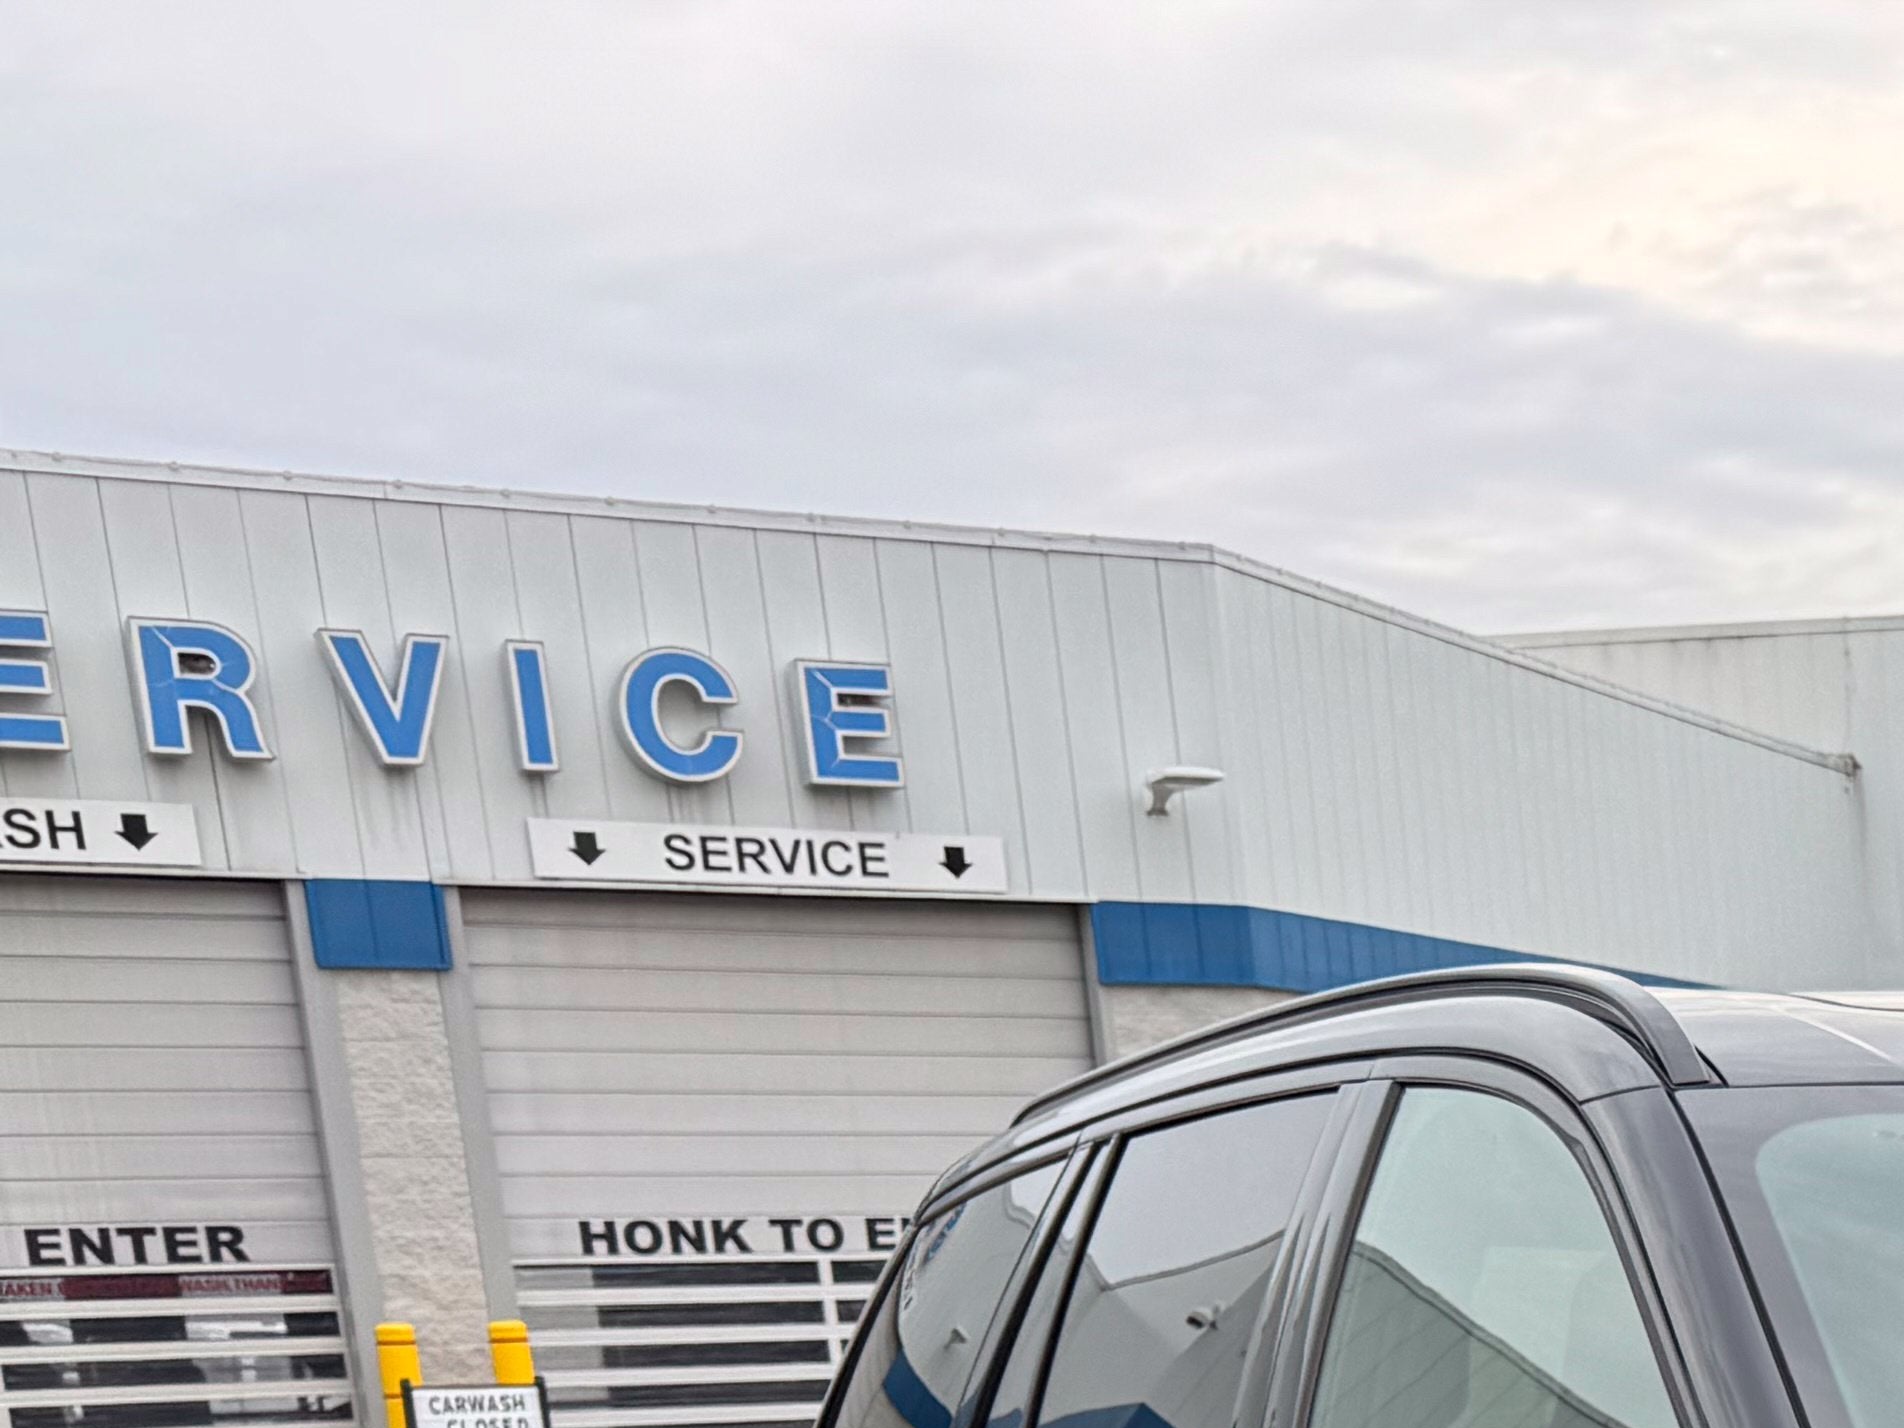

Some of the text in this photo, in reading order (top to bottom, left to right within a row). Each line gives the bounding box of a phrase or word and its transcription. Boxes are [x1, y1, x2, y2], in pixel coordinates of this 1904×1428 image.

[0, 808, 86, 851] SH
[663, 832, 891, 879] SERVICE
[23, 1225, 252, 1267] ENTER
[579, 1219, 753, 1256] HONK
[769, 1218, 844, 1252] TO
[865, 1218, 912, 1250] E
[429, 1394, 526, 1415] CARWASH
